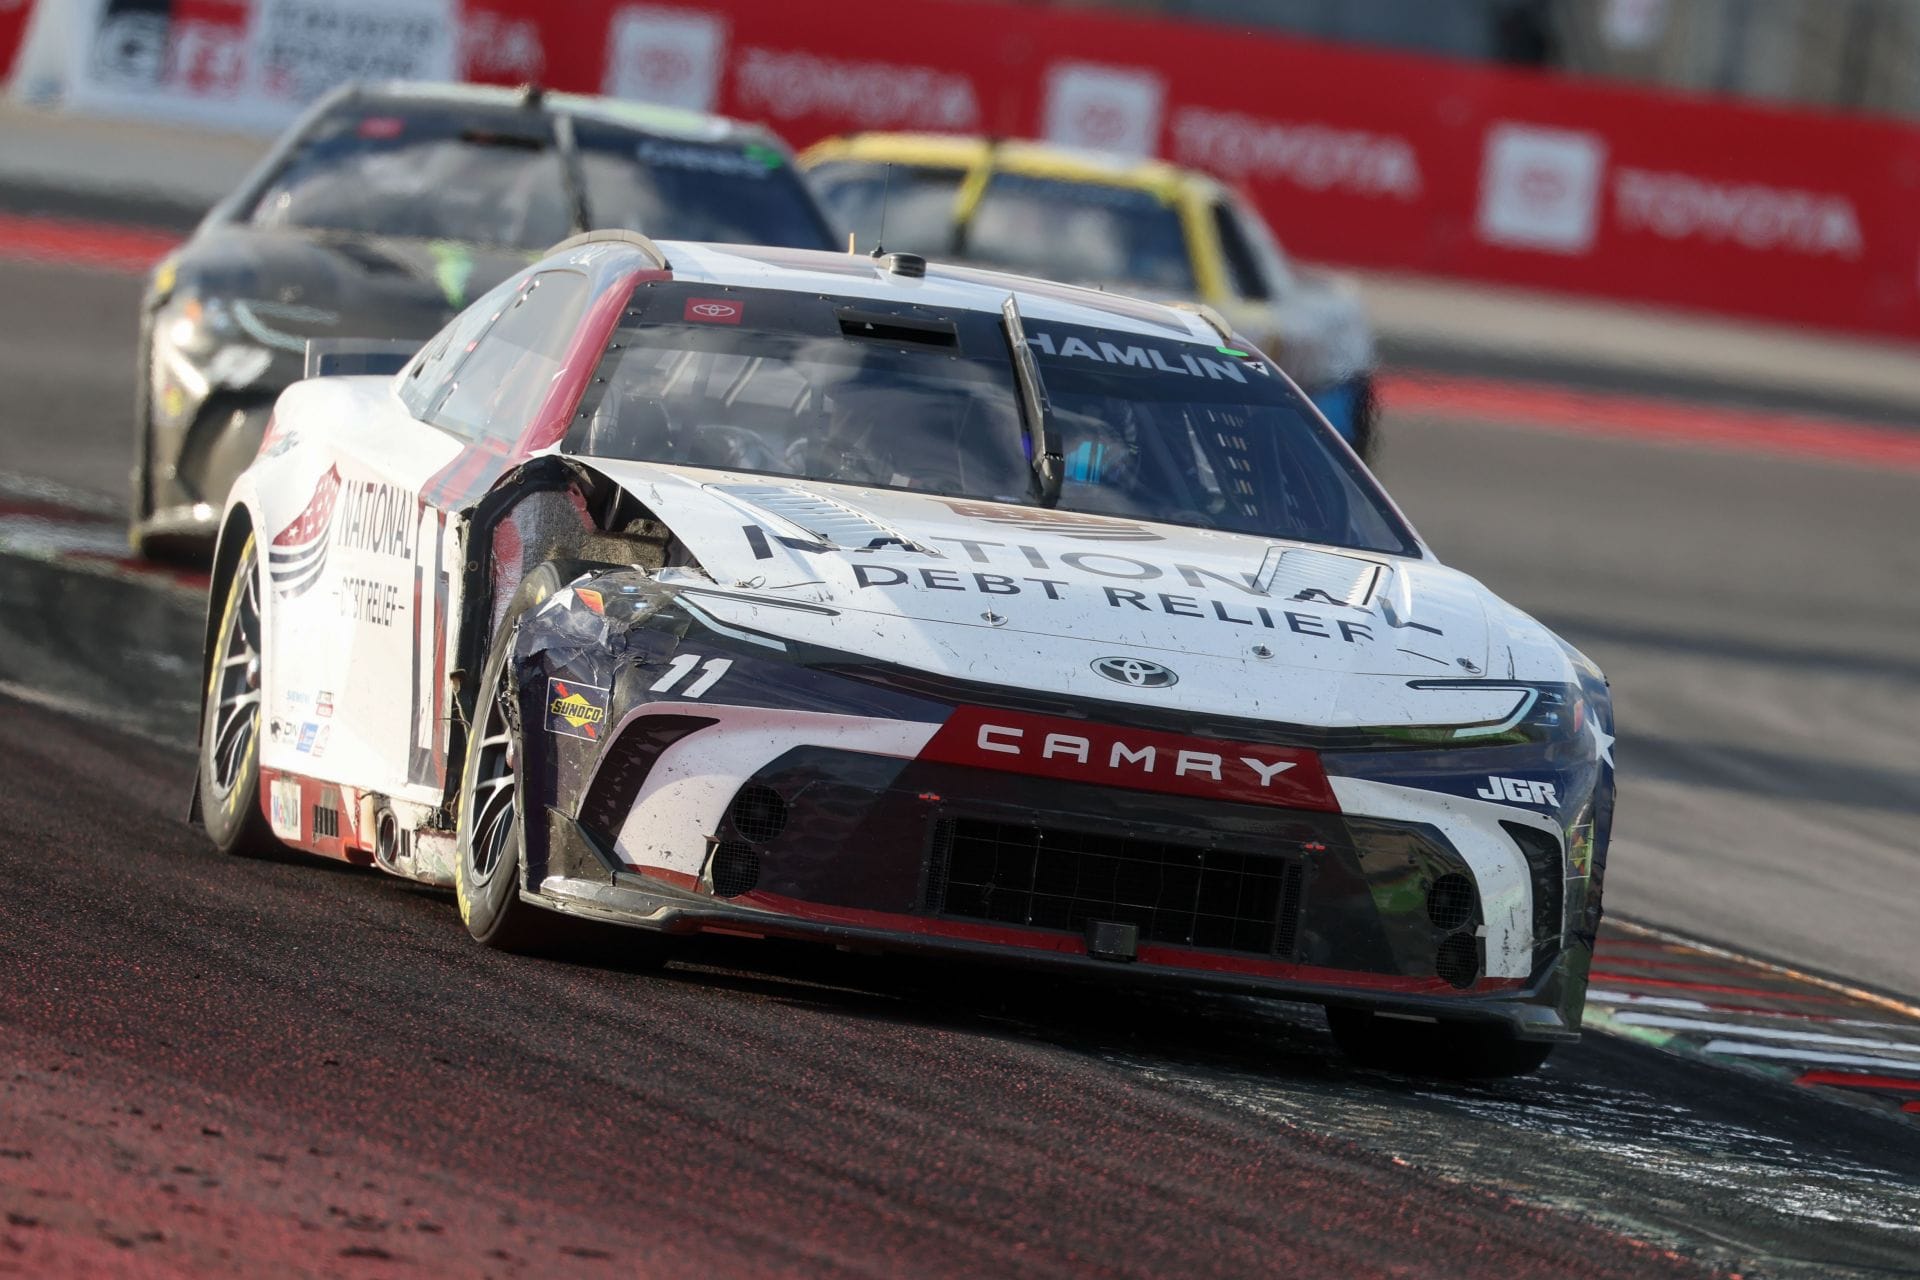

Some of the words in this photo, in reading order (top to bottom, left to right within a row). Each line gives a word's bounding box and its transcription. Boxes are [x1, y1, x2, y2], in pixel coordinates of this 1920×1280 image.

[1027, 333, 1248, 384] HAMLIN
[338, 479, 412, 559] NATIONAL
[852, 563, 1069, 601] DEBT
[1101, 586, 1374, 642] RELIEF
[650, 654, 733, 698] 11
[552, 699, 601, 721] SUNOCO
[977, 724, 1297, 786] CAMRY
[1477, 775, 1560, 808] JGR
